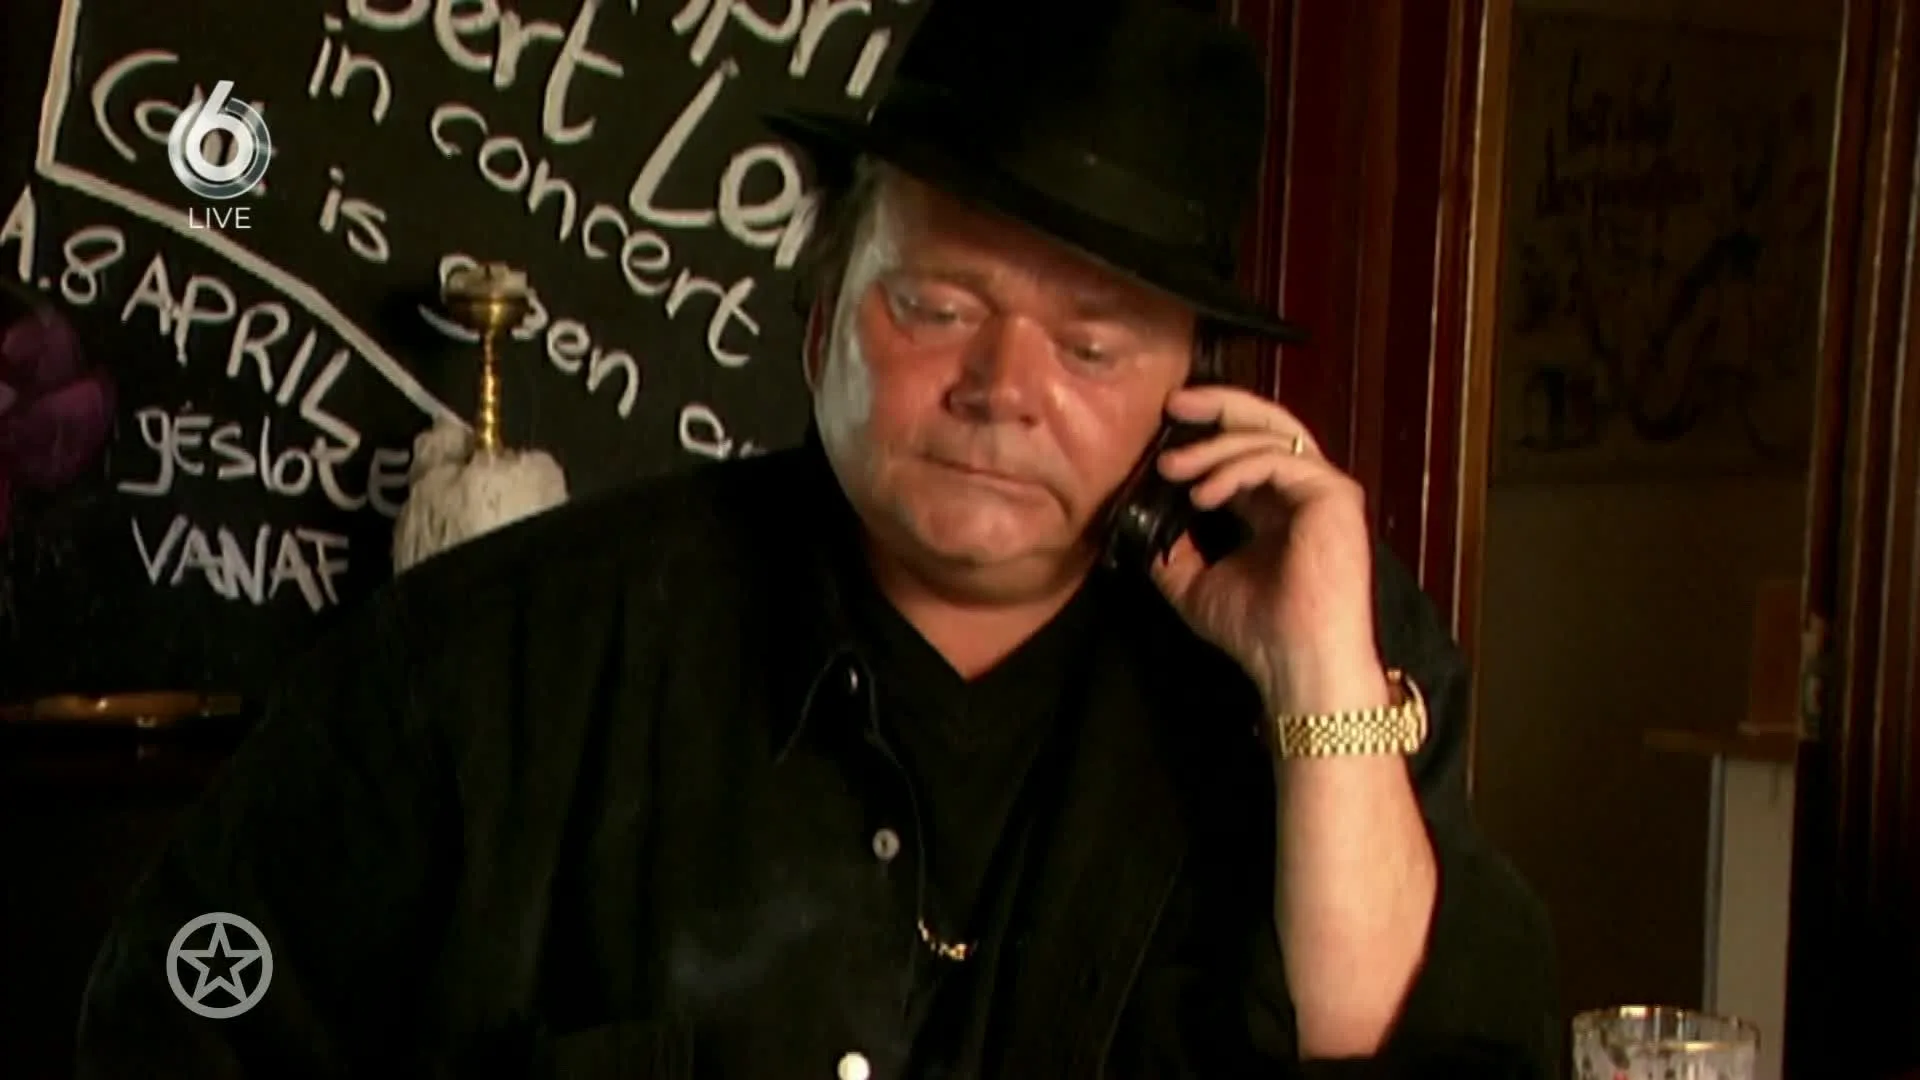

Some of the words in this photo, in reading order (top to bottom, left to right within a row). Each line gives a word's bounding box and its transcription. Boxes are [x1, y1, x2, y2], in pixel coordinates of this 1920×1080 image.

[308, 12, 392, 125] in
[429, 102, 760, 367] concert
[319, 167, 390, 263] is
[121, 250, 362, 446] APRIL
[130, 512, 350, 615] VANAF
